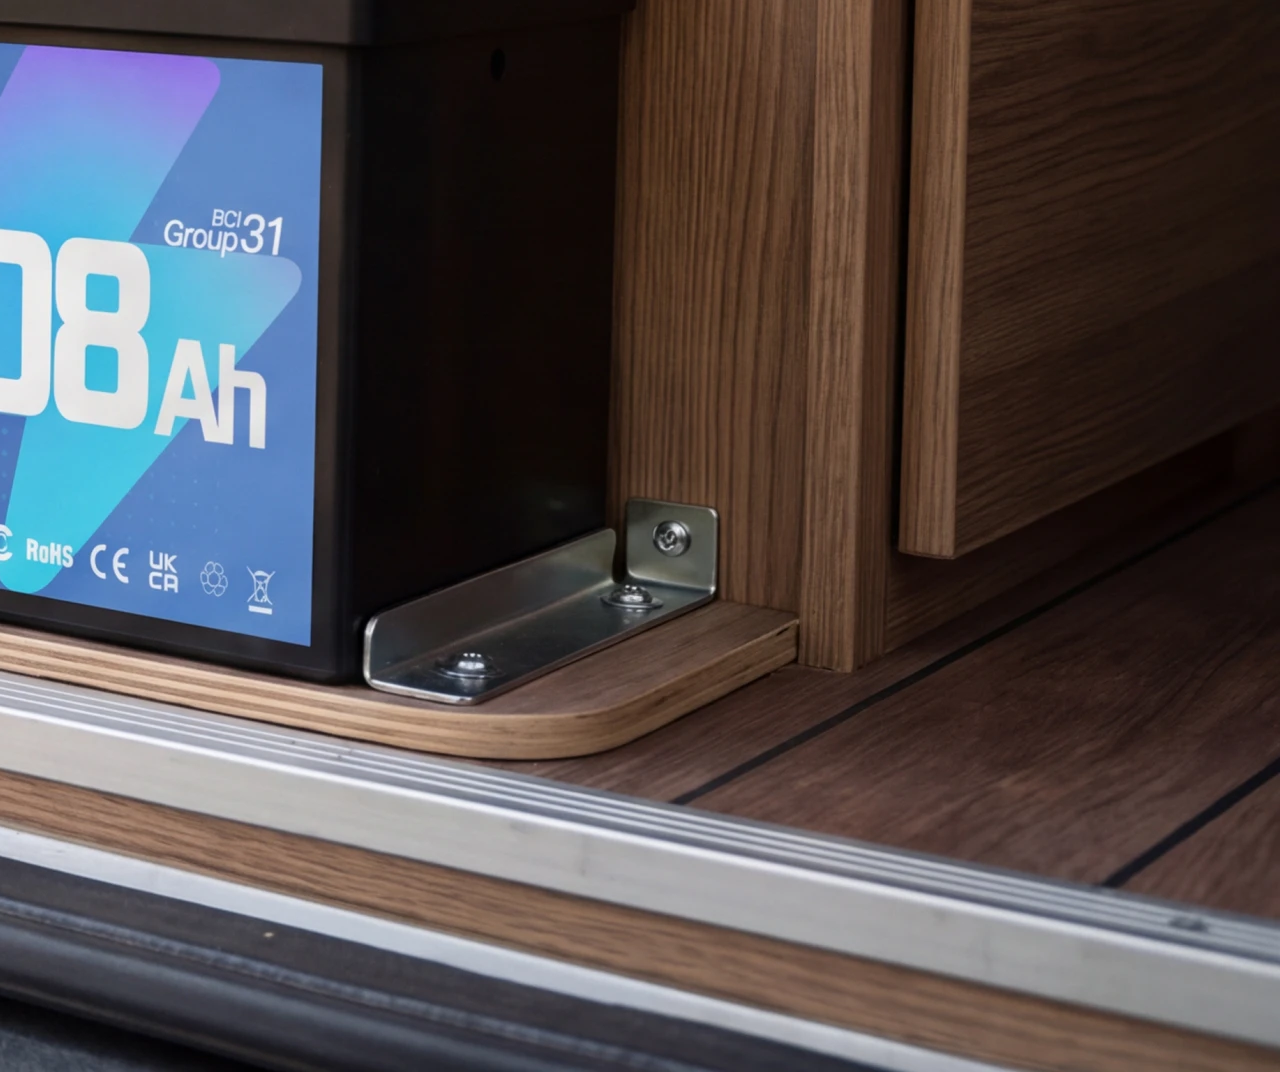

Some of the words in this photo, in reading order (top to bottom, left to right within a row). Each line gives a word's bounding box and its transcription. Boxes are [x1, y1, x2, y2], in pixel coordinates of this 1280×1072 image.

[211, 208, 242, 229] BCI
[163, 218, 239, 259] Group
[240, 213, 284, 257] 31
[153, 337, 267, 450] Ah
[89, 543, 130, 584] CE
[148, 549, 179, 574] UK
[148, 571, 179, 594] CA
